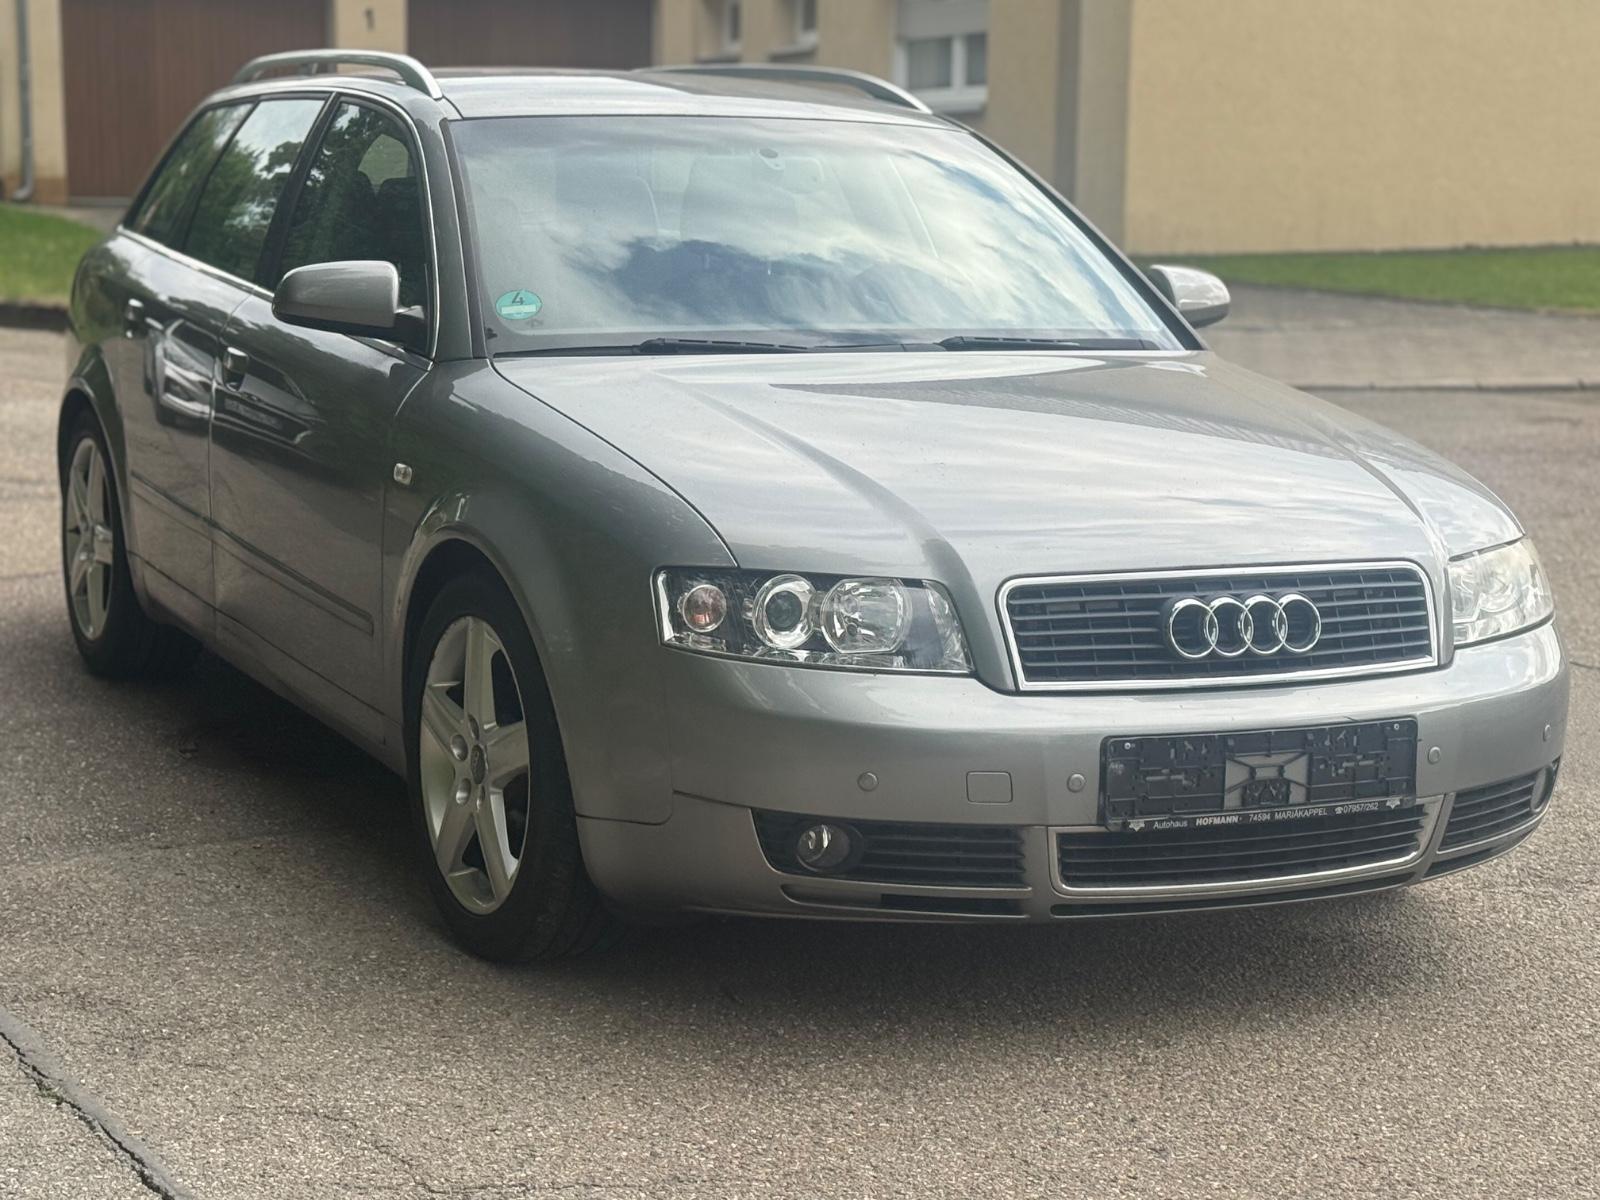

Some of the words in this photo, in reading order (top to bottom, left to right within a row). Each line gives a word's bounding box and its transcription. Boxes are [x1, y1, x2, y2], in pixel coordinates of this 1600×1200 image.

[512, 292, 525, 305] 4
[1153, 820, 1188, 829] Autohaus
[1196, 815, 1239, 826] HOFMANN
[1249, 813, 1271, 822] 74594
